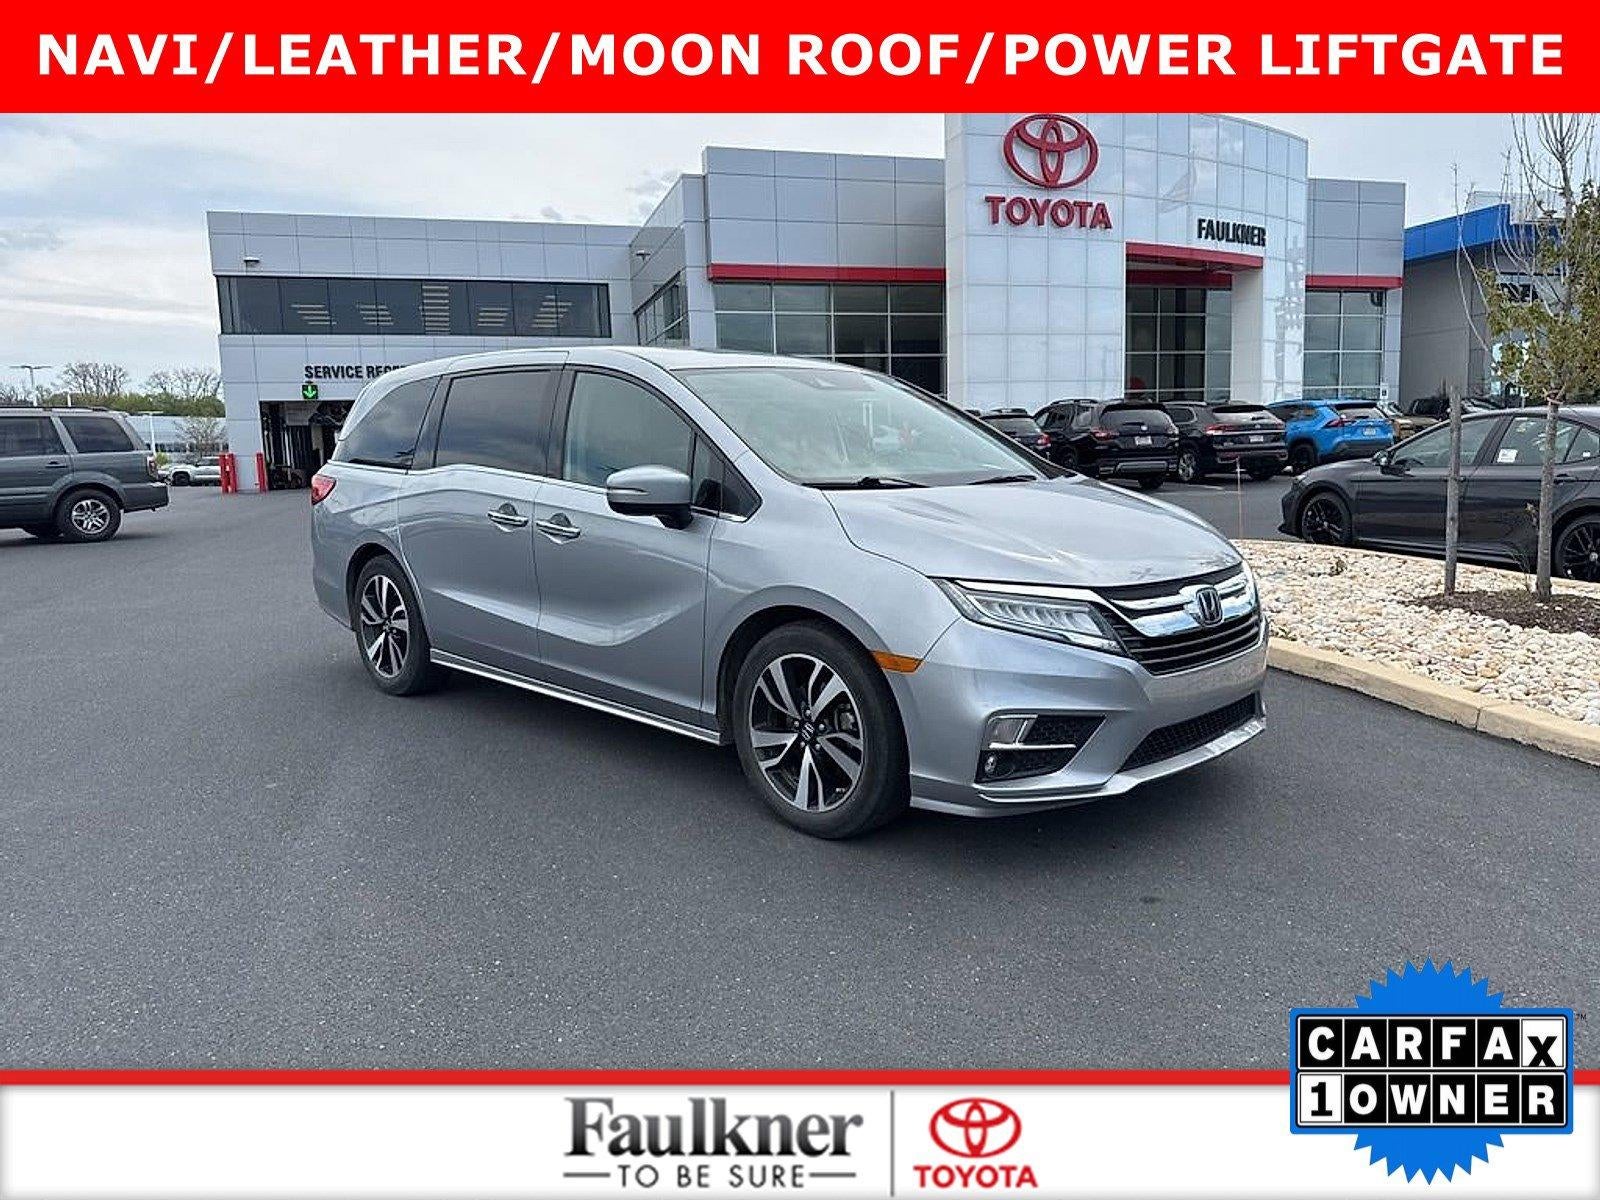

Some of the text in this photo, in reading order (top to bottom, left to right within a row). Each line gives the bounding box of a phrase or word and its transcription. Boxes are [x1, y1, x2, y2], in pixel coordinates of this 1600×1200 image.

[985, 195, 1112, 230] TOYOTA
[1197, 218, 1267, 247] FAULKNER
[304, 365, 363, 379] SERVICE
